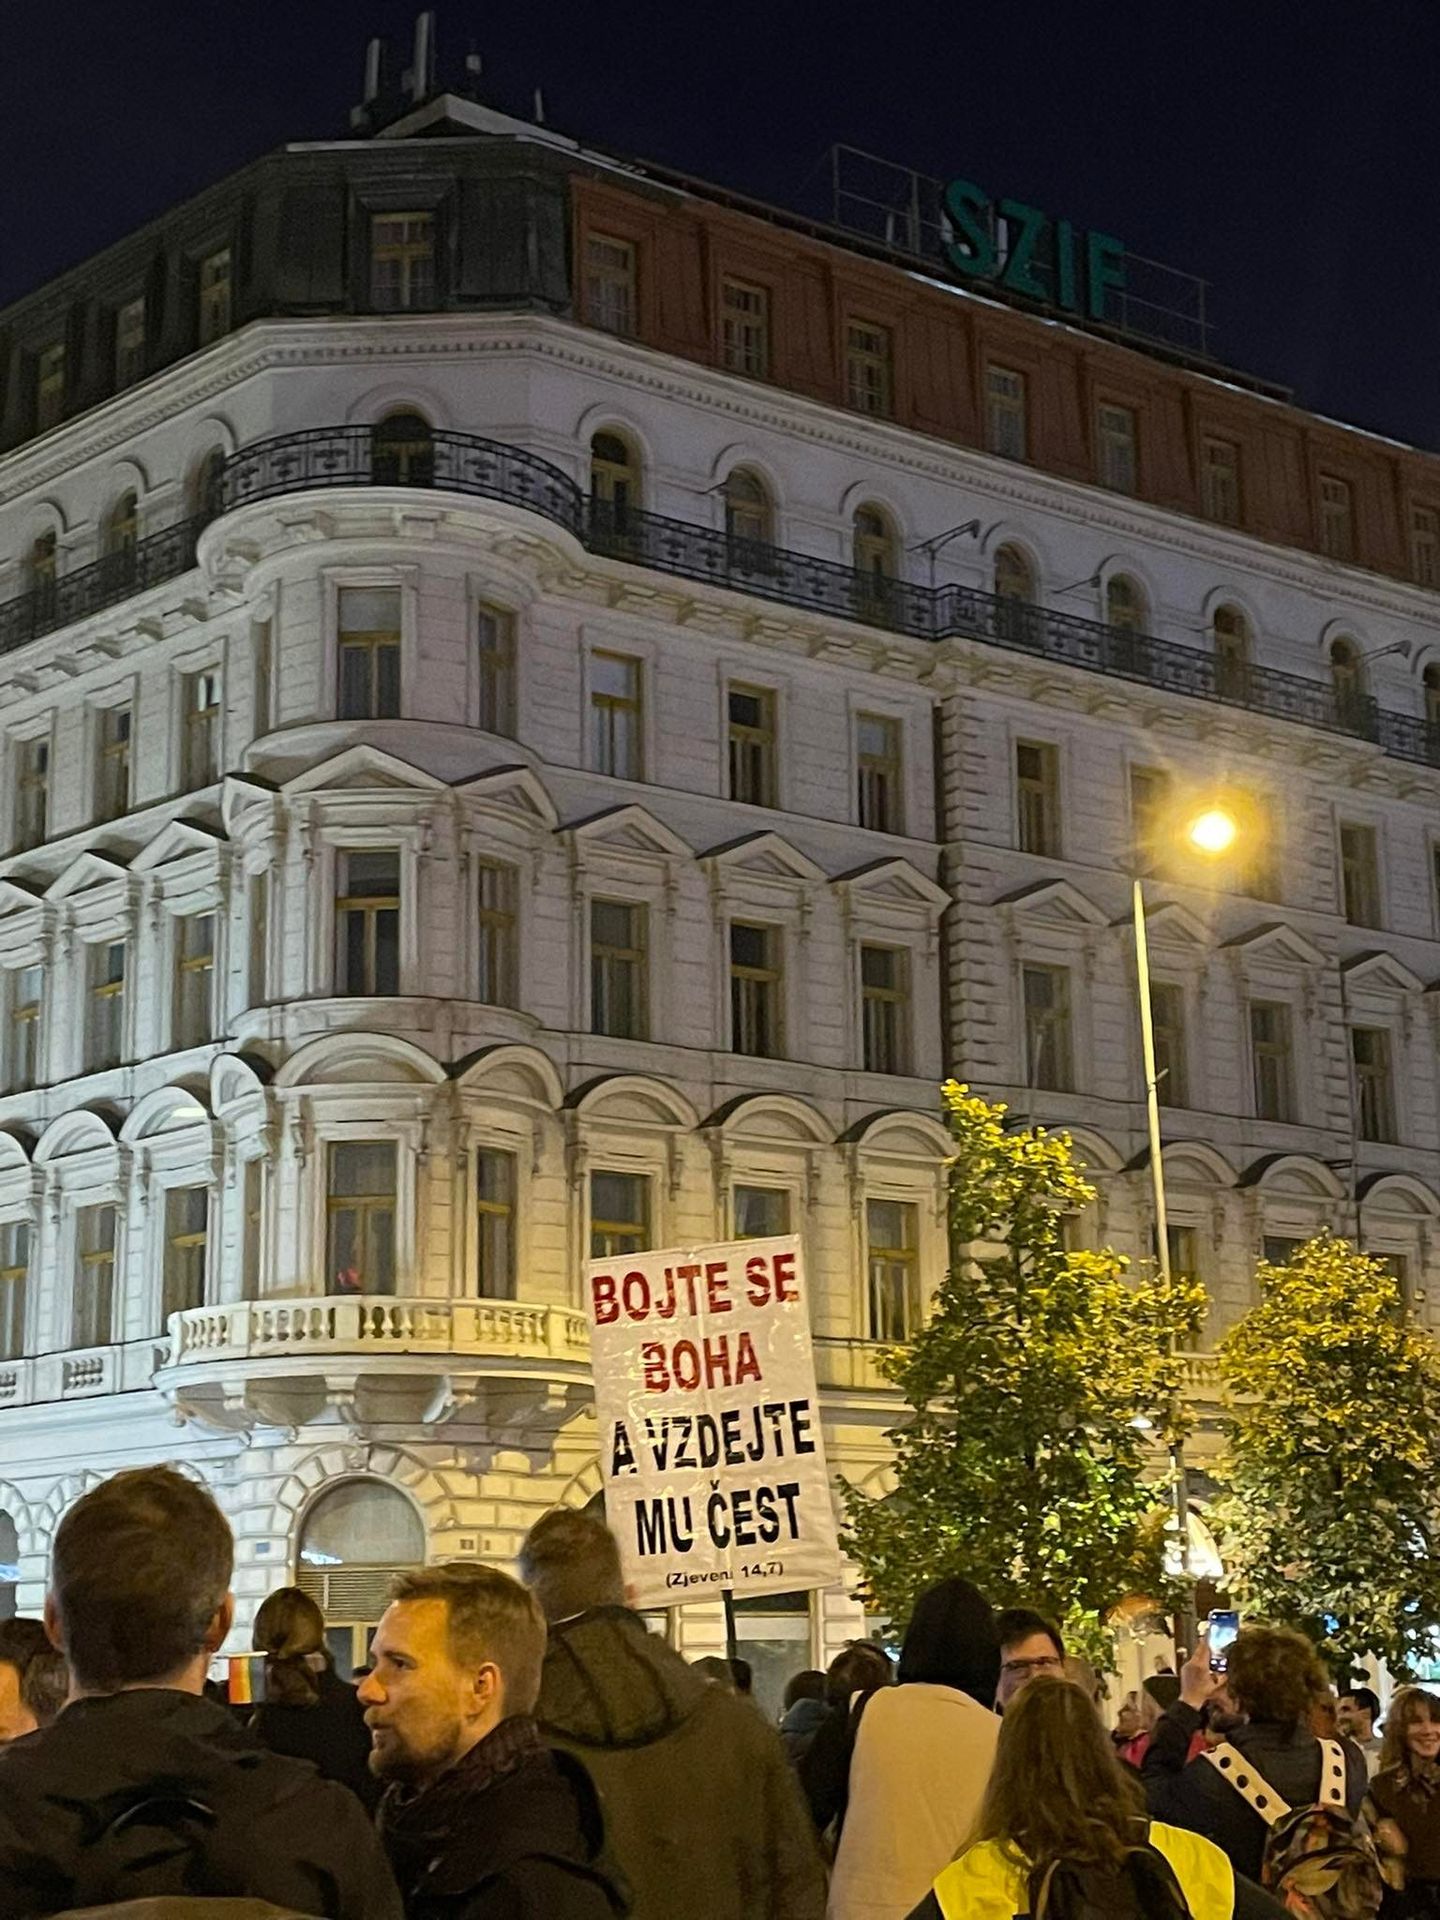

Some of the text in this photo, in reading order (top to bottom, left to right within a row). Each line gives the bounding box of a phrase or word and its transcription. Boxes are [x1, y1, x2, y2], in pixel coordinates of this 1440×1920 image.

[943, 179, 1127, 319] SZIF
[591, 1253, 799, 1325] BOJTE SE
[641, 1332, 762, 1393] BOHA
[612, 1399, 815, 1476] A VZDEJTE
[635, 1480, 801, 1556] MU ČEST
[741, 1561, 784, 1578] 14,7)
